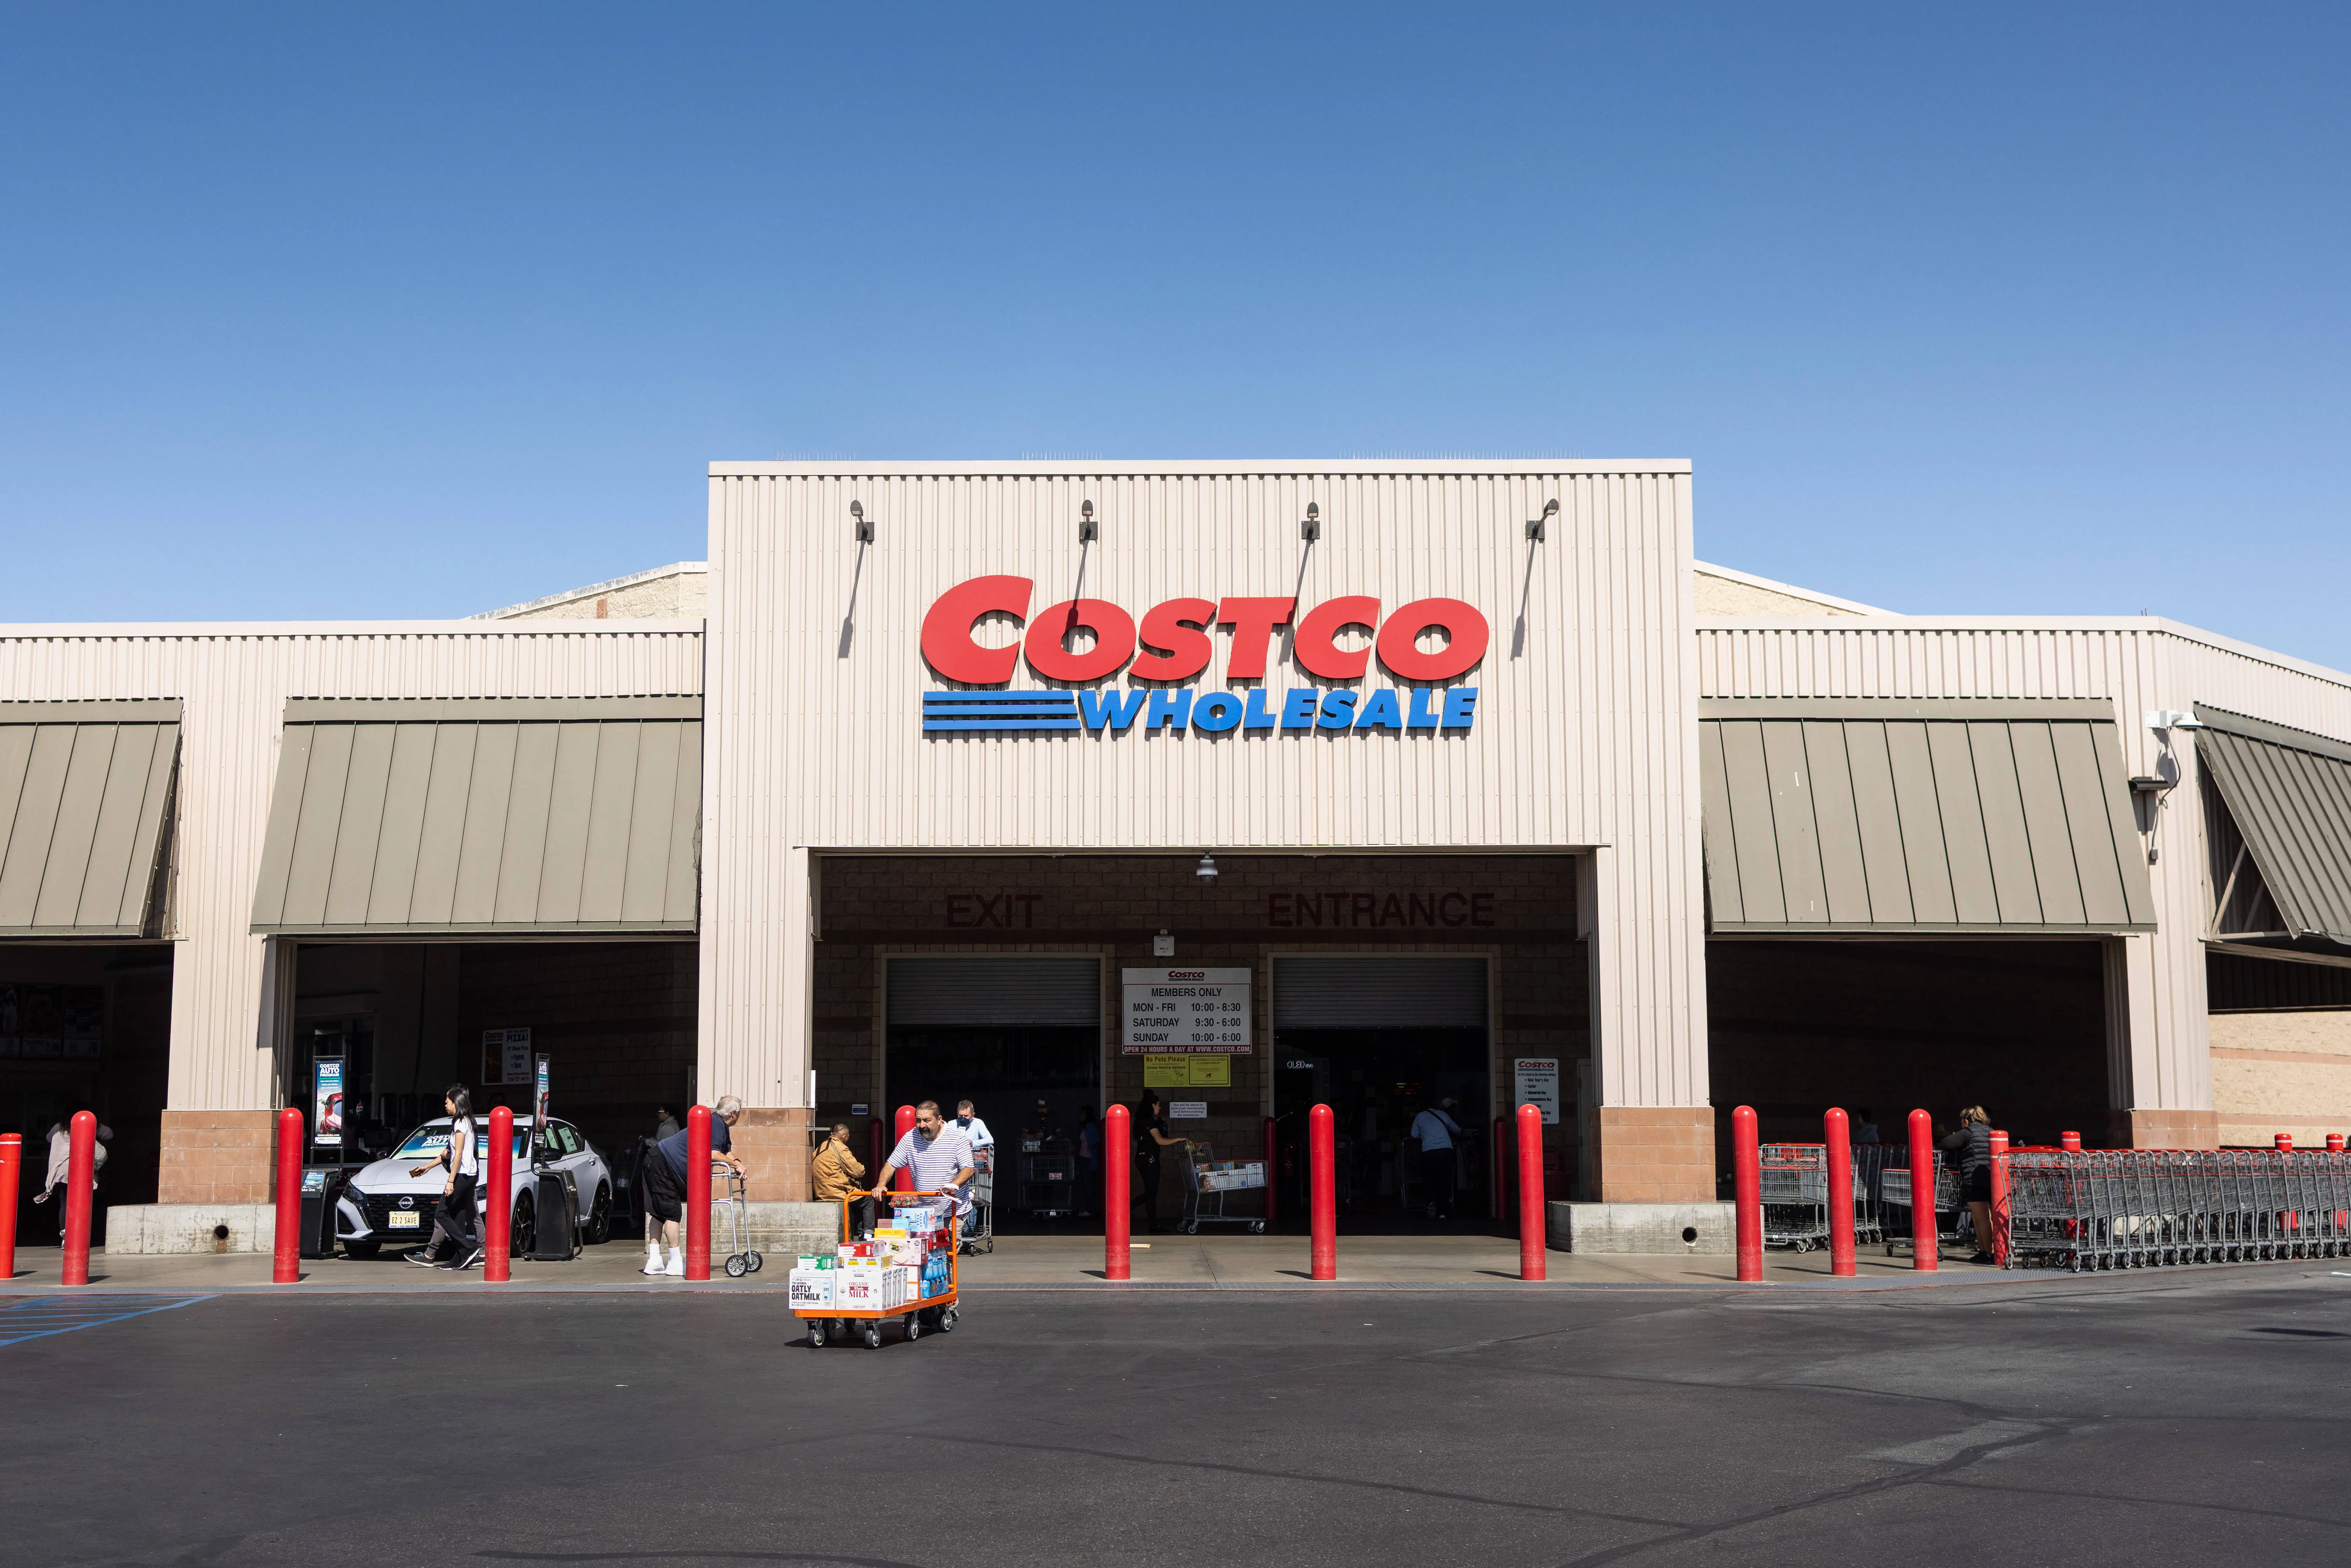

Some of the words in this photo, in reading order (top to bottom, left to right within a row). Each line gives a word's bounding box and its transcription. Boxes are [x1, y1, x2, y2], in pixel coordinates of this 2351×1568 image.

[921, 574, 1489, 684] COSTCO
[1078, 688, 1478, 732] WHOLESALE
[947, 894, 1043, 928] EXIT
[1269, 892, 1495, 927] ENTRANCE
[1151, 988, 1196, 997] MEMBERS
[1199, 988, 1222, 997] ONLY
[1133, 1003, 1153, 1011] MON
[1161, 1003, 1176, 1011] FRI
[1191, 1003, 1214, 1011] 10:00
[1222, 1003, 1240, 1011] 8:30
[1133, 1018, 1180, 1026] SATURDAY
[1195, 1018, 1214, 1026] 9:30
[1222, 1018, 1241, 1026] 6:00
[507, 1033, 528, 1042] PIZZA!
[1133, 1033, 1169, 1042] SUNDAY
[1191, 1033, 1214, 1041] 10:00
[1222, 1033, 1241, 1041] 6:00
[1287, 1060, 1305, 1069] OLED
